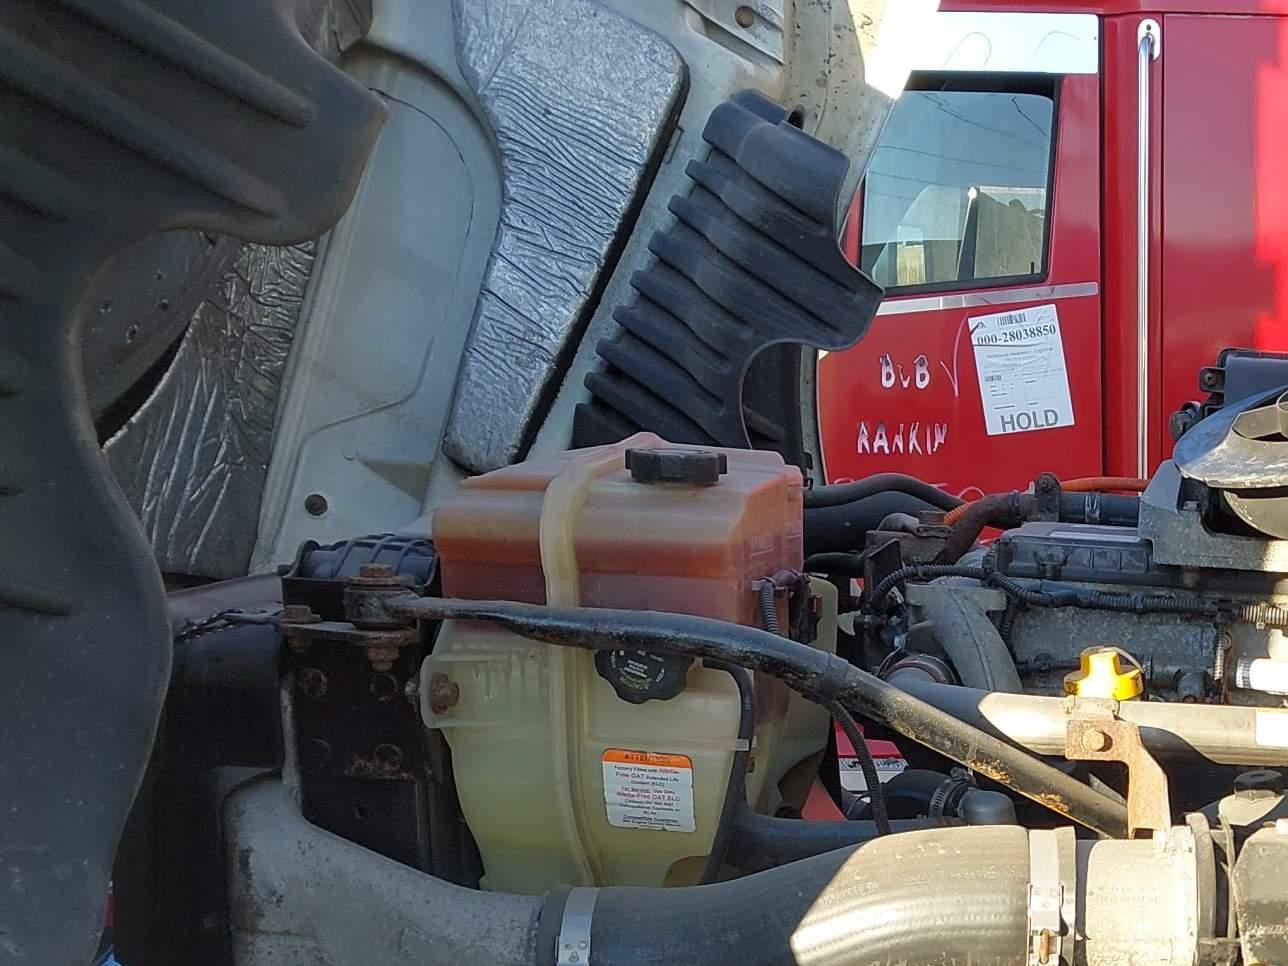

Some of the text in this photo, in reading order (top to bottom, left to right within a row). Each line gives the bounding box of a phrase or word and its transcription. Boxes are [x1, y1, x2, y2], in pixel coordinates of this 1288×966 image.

[977, 323, 1056, 345] 000-28038850
[1000, 409, 1059, 432] HOLD
[857, 421, 948, 455] RANKIN
[624, 753, 671, 764] ATTENTION
